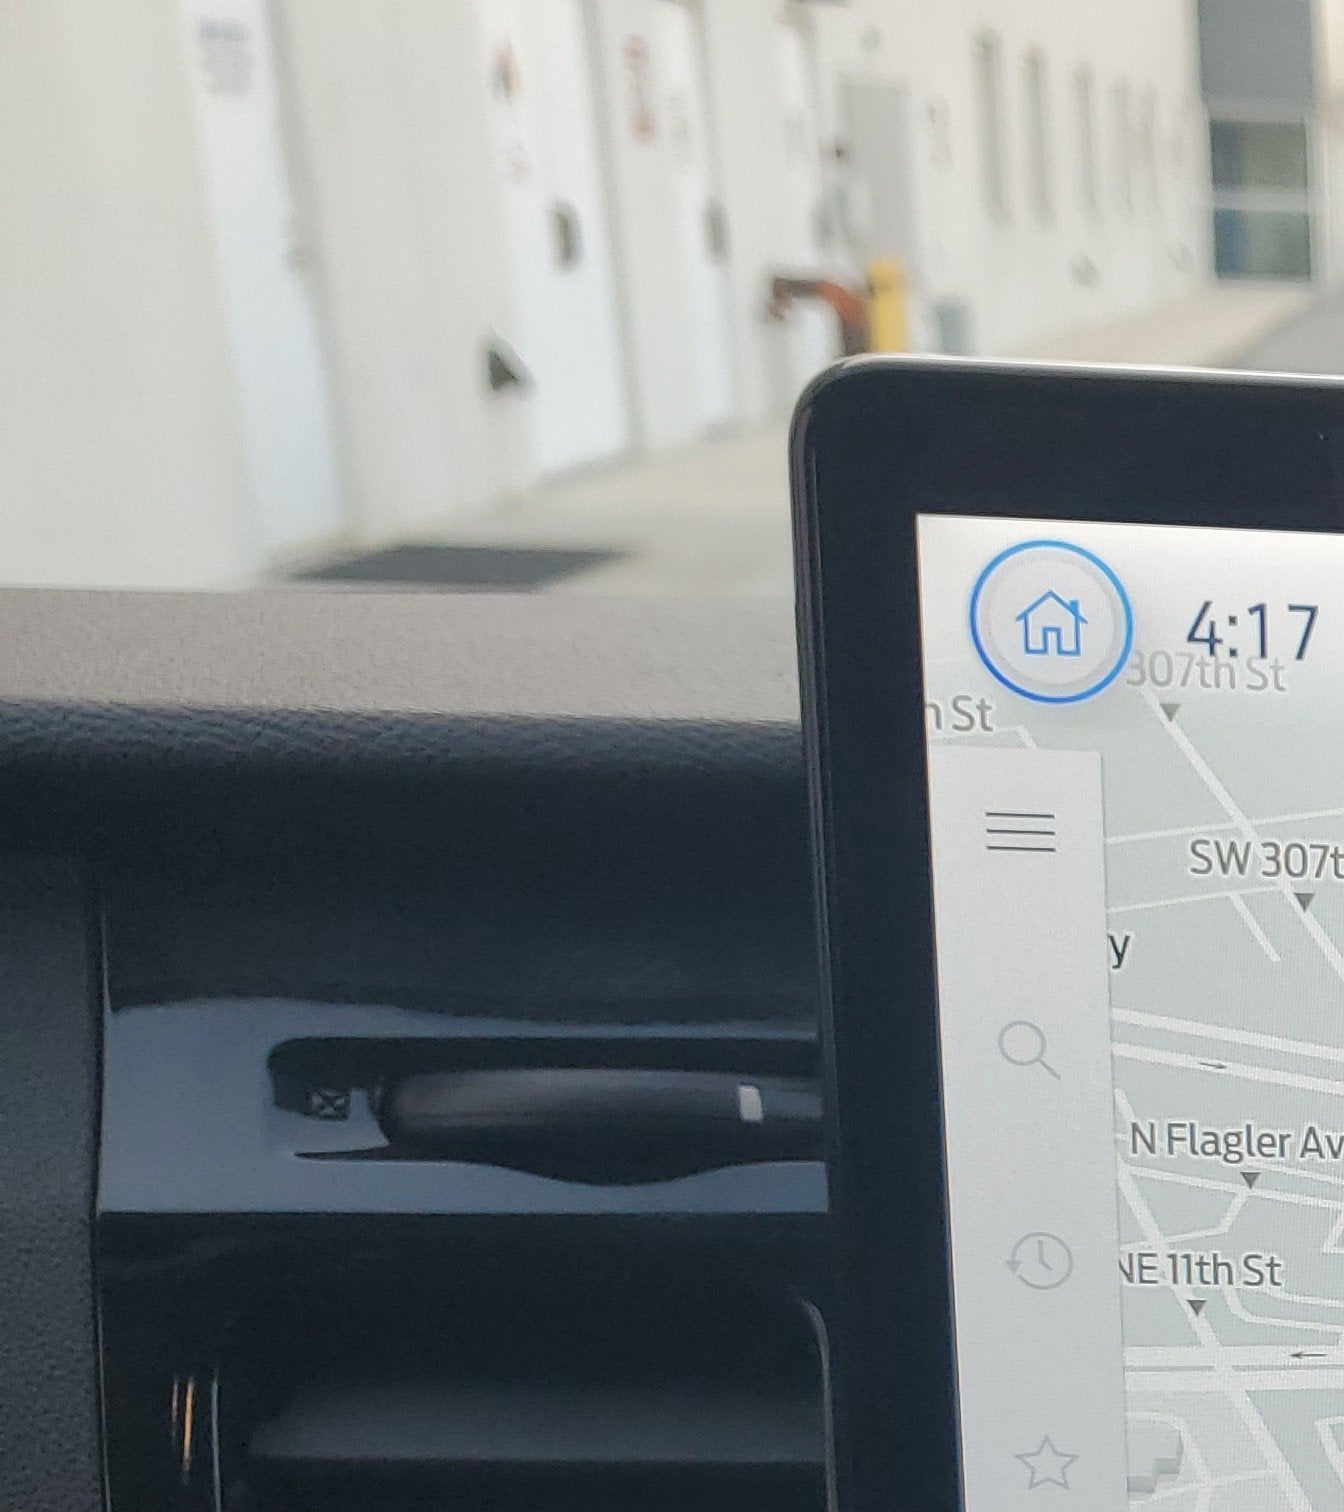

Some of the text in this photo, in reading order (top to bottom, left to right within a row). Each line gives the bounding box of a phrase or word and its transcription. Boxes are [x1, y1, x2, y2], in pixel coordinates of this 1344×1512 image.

[1186, 600, 1319, 661] 4:17
[1246, 656, 1286, 692] St
[952, 694, 993, 732] St
[1190, 841, 1252, 876] SW
[1130, 1122, 1158, 1155] N
[1167, 1122, 1291, 1164] Flagler
[1119, 1253, 1282, 1286] NE 11th St
